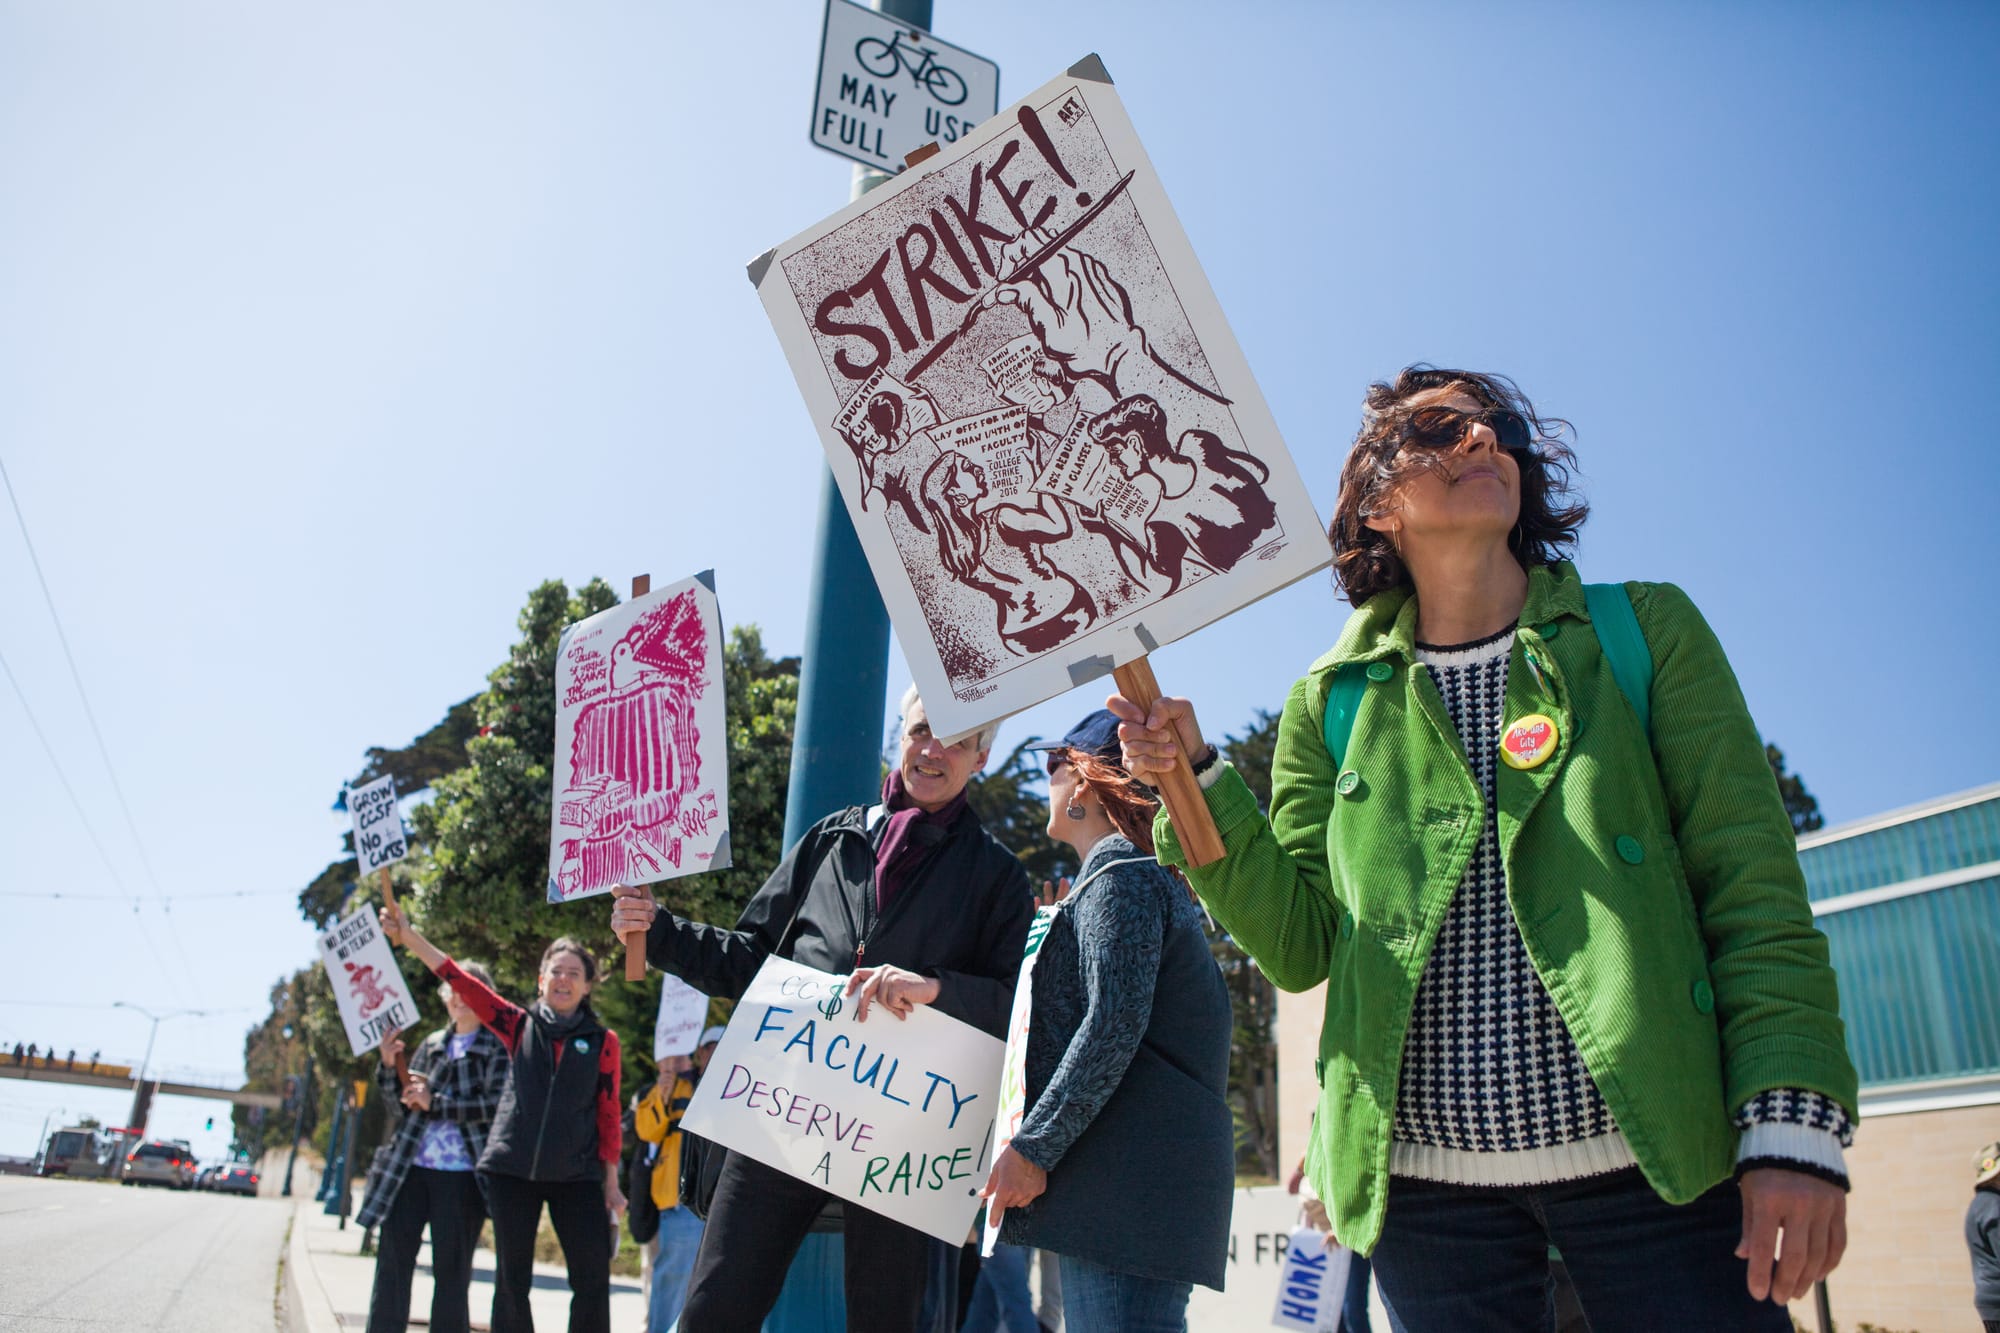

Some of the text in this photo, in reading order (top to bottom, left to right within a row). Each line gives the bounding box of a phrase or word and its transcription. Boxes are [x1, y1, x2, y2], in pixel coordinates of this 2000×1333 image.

[839, 72, 897, 119] MAY
[1057, 96, 1080, 123] AFT
[822, 107, 889, 160] FULL
[814, 105, 1093, 380] STRIKE!
[987, 347, 1009, 367] ADMIN
[991, 345, 1031, 375] REFUSES TO
[1004, 347, 1043, 378] NEGOTIATE
[1005, 370, 1031, 390] CONTRACT
[839, 368, 885, 428] EDUCATION
[852, 414, 870, 437] CUT
[934, 406, 1028, 442] LAY OFFS FOR MORE
[955, 433, 981, 448] THAN
[1013, 419, 1026, 429] OF
[981, 432, 1025, 453] FACULTY
[995, 449, 1012, 460] CITY
[1046, 412, 1089, 489] 26% REDUCTION
[989, 456, 1021, 471] COLLEGE
[993, 466, 1020, 480] STRIKE
[1061, 442, 1092, 496] IN CLASSES
[991, 475, 1023, 490] APRIL 27
[999, 486, 1018, 498] 2016
[1101, 474, 1117, 493] CITY
[1103, 480, 1126, 511] COLLEGE
[1115, 482, 1136, 511] STRIKE
[1120, 488, 1143, 521] APRIL 27
[1133, 498, 1149, 518] 2016
[567, 646, 584, 659] CITY
[566, 684, 585, 697] THE
[352, 780, 393, 812] GROW
[359, 799, 394, 830] CCSF
[360, 833, 381, 855] NO
[369, 839, 405, 868] CUTS
[338, 912, 369, 943] JUSTICE
[754, 1005, 979, 1129] FACULTY
[719, 1064, 875, 1153] DESERVE
[811, 1118, 995, 1197] A RAISE!
[1281, 1247, 1327, 1324] HONK
